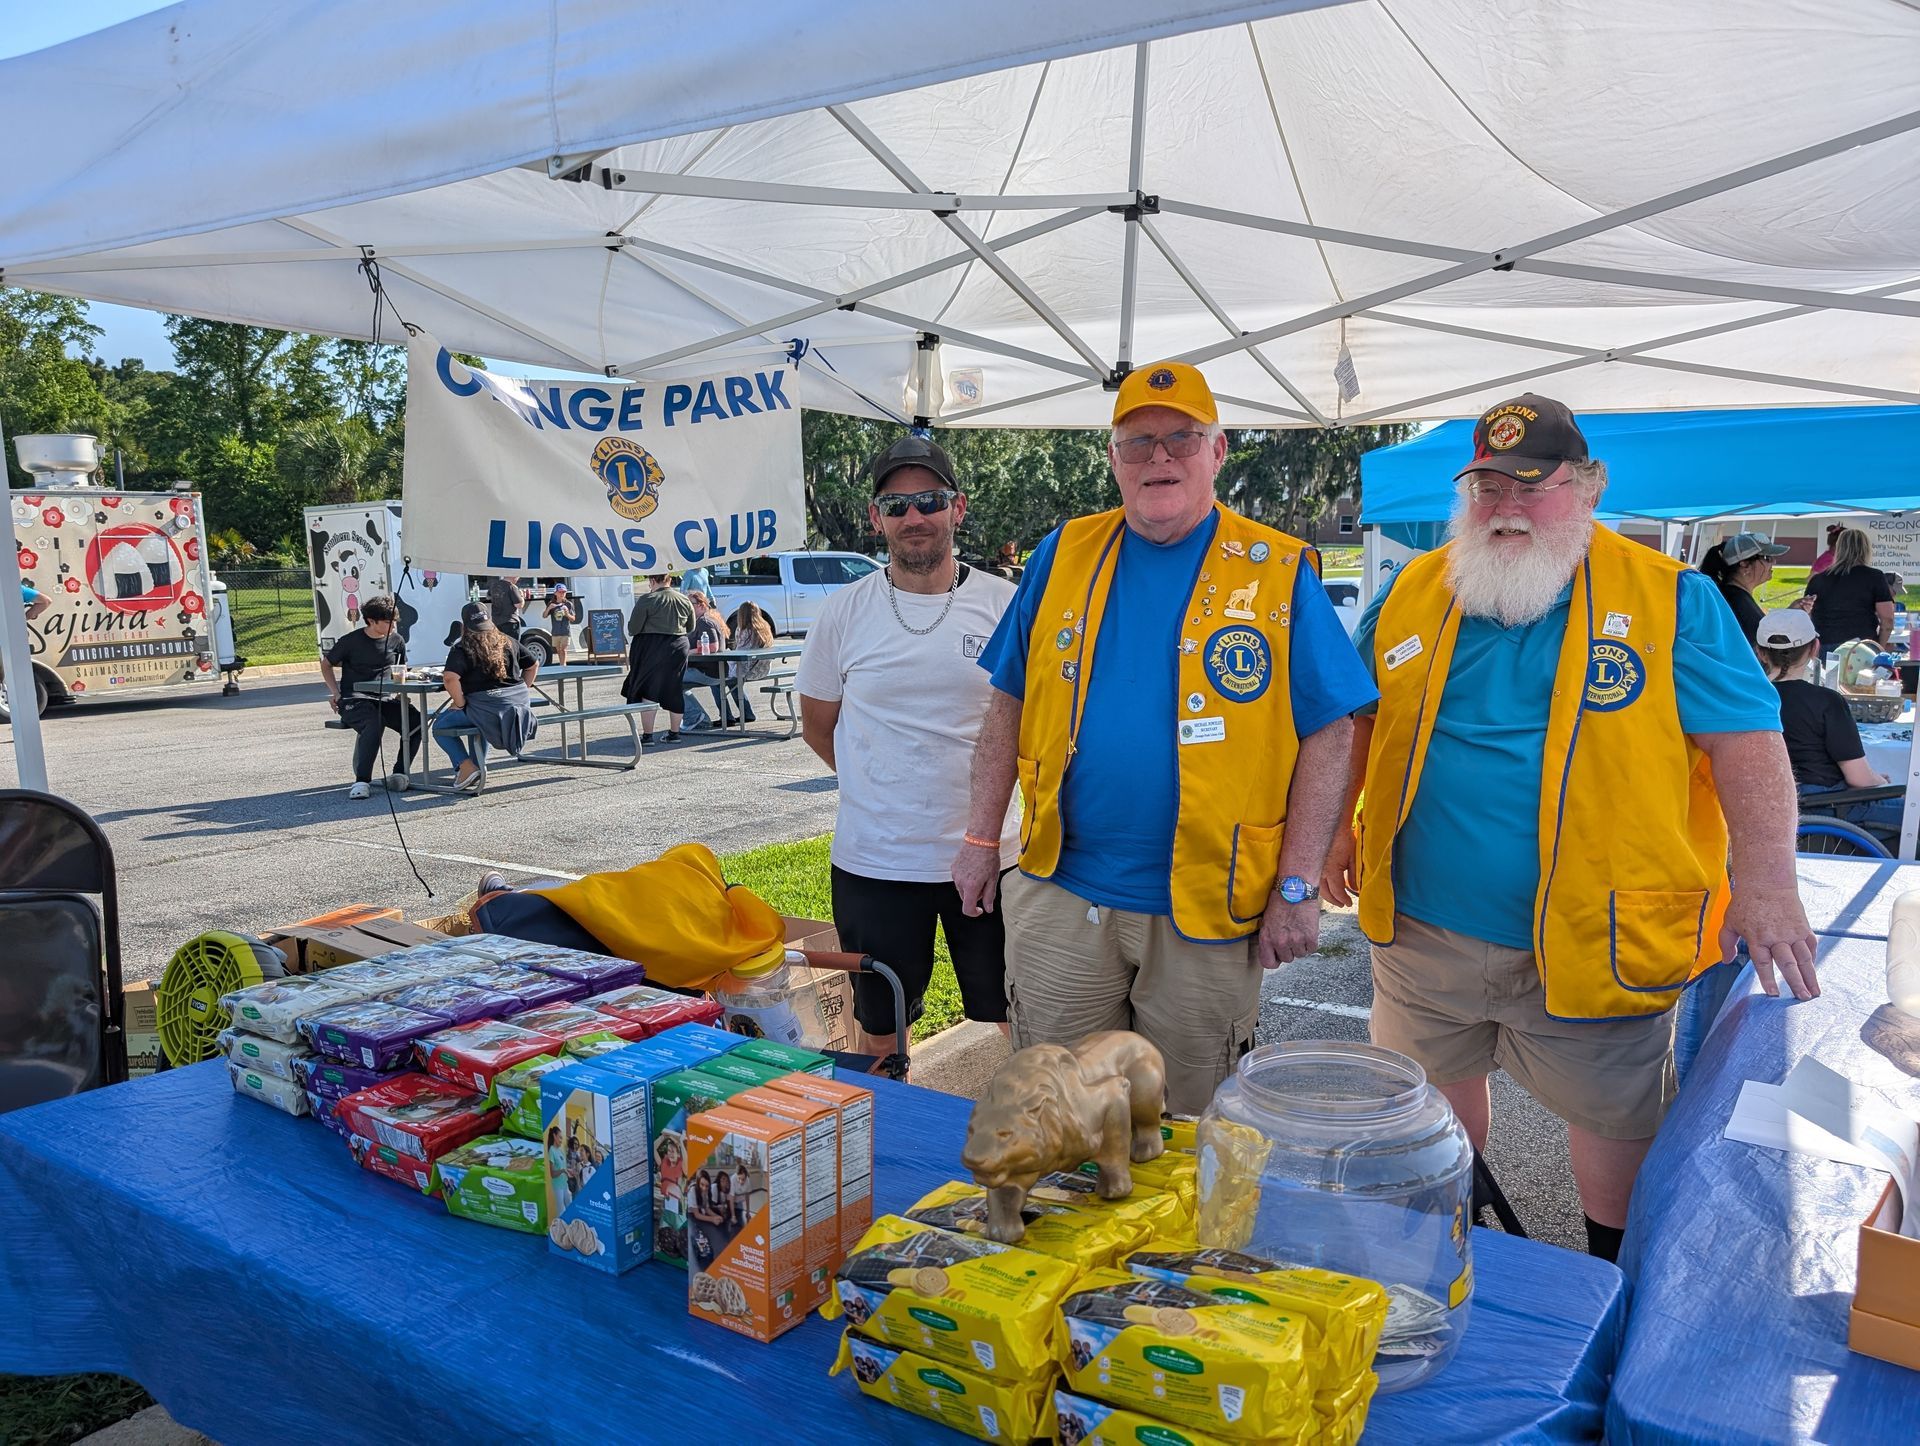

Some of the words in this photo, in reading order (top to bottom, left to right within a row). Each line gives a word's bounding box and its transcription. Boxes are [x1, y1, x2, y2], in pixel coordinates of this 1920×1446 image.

[436, 346, 645, 431] ONGE
[664, 370, 792, 427] PARK
[1485, 405, 1539, 425] MARINE
[600, 439, 641, 457] LIONS
[615, 461, 639, 492] L
[613, 499, 654, 516] INTERNATIONAL
[486, 520, 656, 570] LIONS
[674, 509, 777, 563] CLUB
[73, 633, 115, 643] STREET
[124, 631, 150, 640] FARE
[1221, 633, 1259, 648] LIONS
[72, 646, 115, 662] ONIGIRI
[122, 643, 154, 658] BENTO
[161, 640, 194, 655] BOWLS
[1593, 646, 1626, 660] IONS
[1234, 650, 1251, 672] L
[1595, 663, 1614, 684] L
[1224, 677, 1258, 690] INTERNATIONAL
[1587, 690, 1624, 700] TERNATIONAL
[192, 999, 207, 1012] RYOBI
[589, 1200, 612, 1211] trefoils
[740, 1244, 765, 1257] peanut
[743, 1252, 765, 1265] butter
[731, 1257, 765, 1273] sandwich
[979, 1263, 1029, 1284] lemonades
